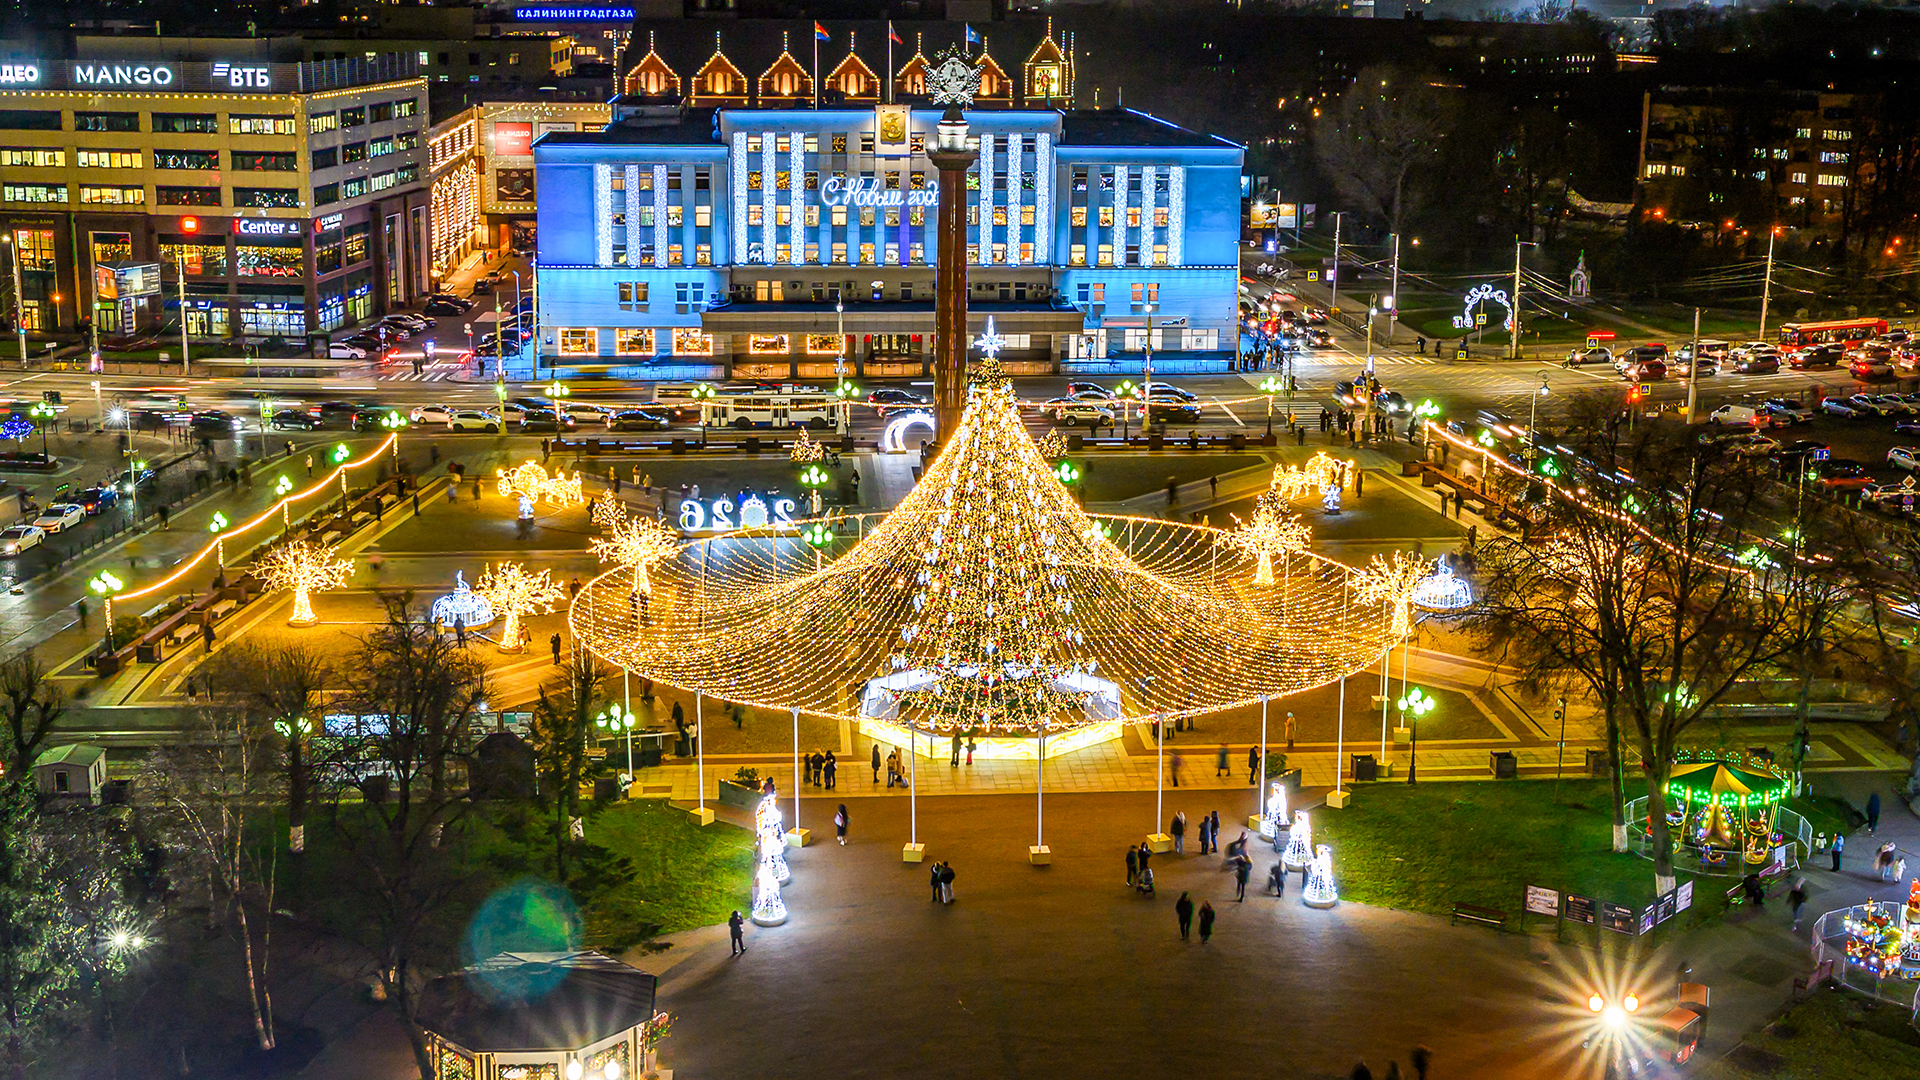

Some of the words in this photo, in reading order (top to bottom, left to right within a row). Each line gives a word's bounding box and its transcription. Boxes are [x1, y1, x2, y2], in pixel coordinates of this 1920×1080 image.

[517, 9, 634, 19] КАЛИНИНГРАДГАЗА
[0, 65, 39, 83] ДЕО
[75, 65, 172, 85] MANGO
[230, 68, 270, 87] ВТБ
[842, 177, 905, 206] Новым
[233, 218, 285, 235] iCenter
